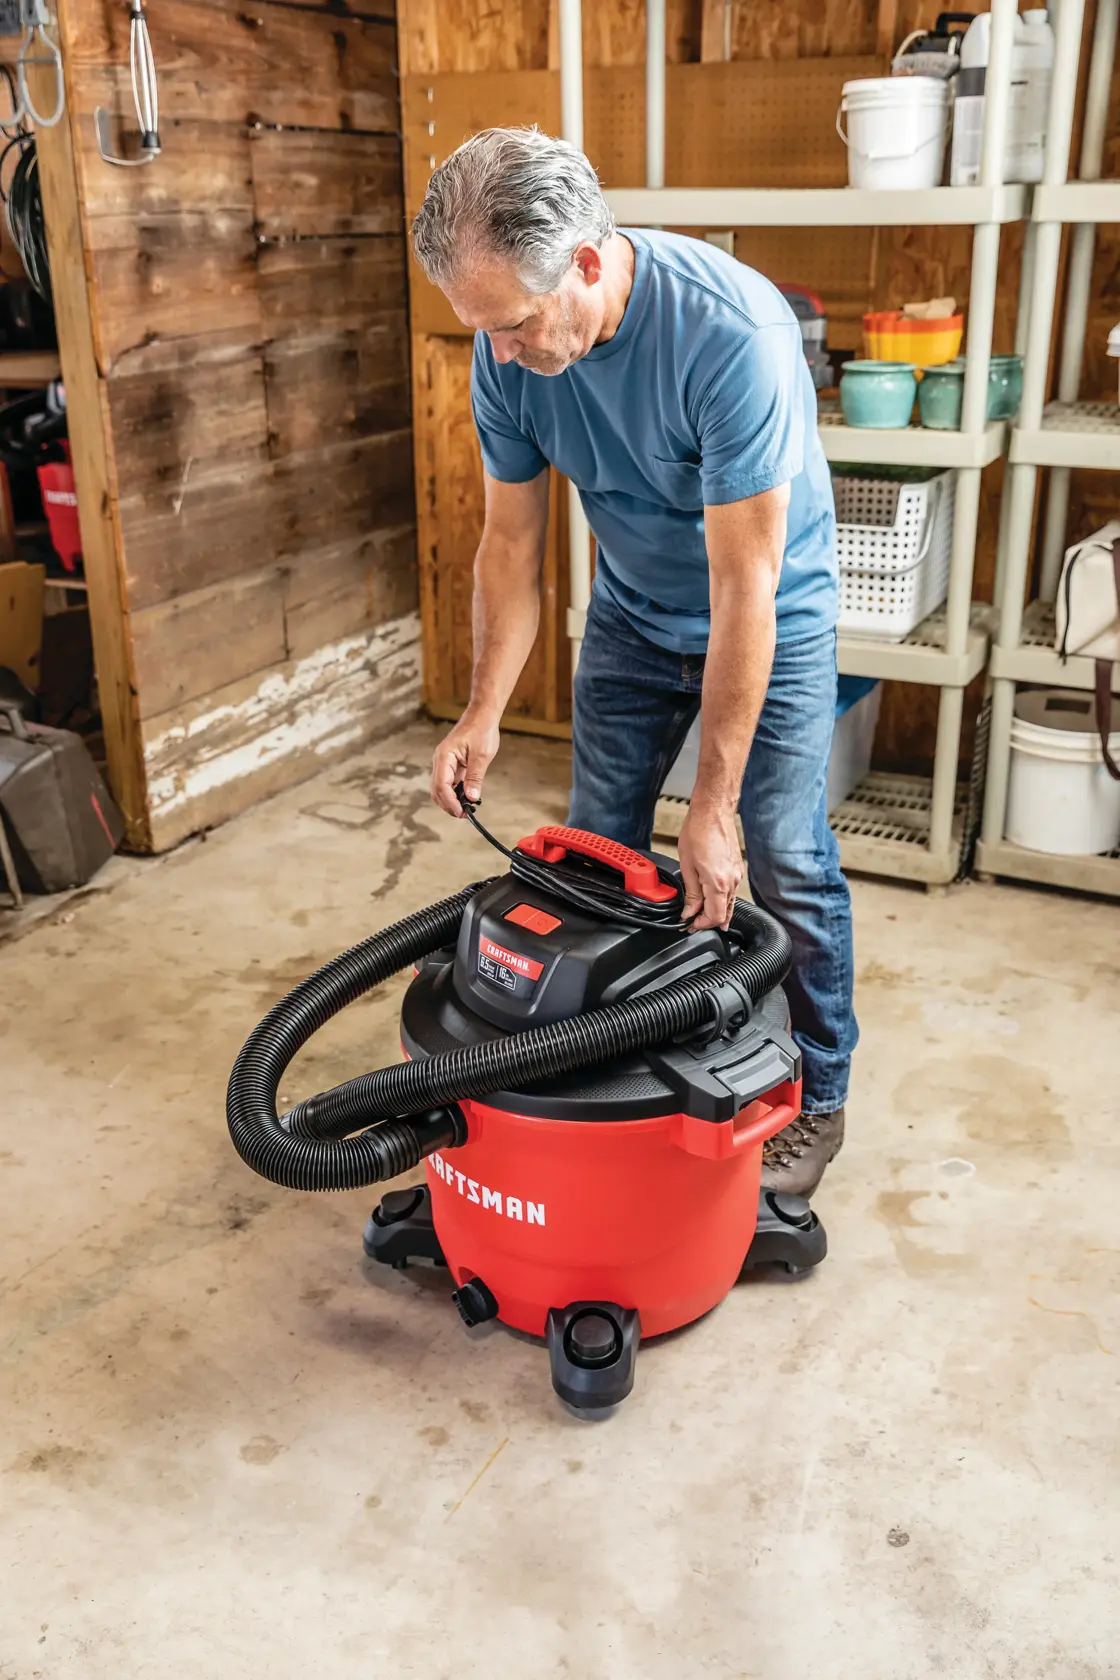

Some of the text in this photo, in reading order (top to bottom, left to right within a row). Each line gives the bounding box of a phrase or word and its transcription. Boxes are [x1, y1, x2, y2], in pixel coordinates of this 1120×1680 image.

[487, 944, 529, 971] CRAFTSMAN
[499, 967, 507, 979] 16
[428, 1152, 546, 1226] RAFTSMAN
